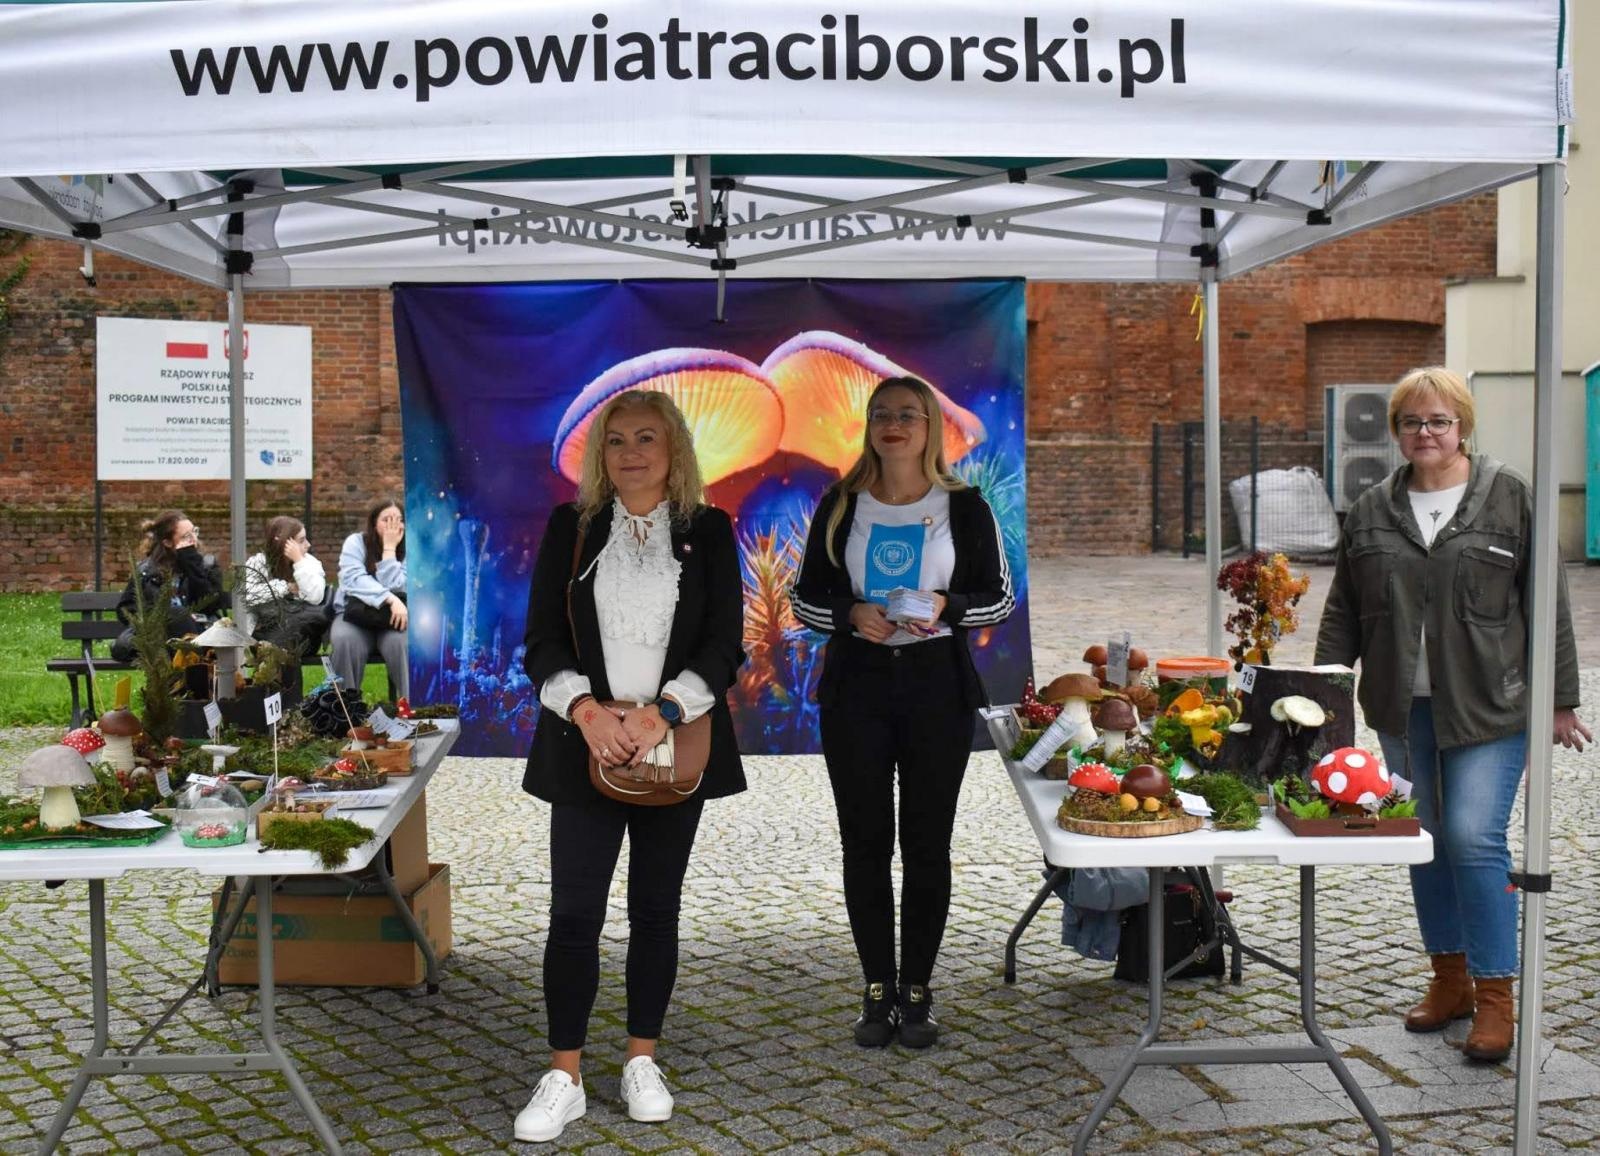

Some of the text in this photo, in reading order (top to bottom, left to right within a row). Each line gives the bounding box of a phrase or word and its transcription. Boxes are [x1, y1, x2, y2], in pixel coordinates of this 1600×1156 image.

[170, 13, 1186, 102] www.powiatraciborski.pl
[160, 369, 254, 380] RZĄDOWY FUNSZ
[181, 382, 214, 391] POLSKI
[109, 393, 302, 406] PROGRAM INWESTYCJI STTEGICZNYCH
[166, 417, 249, 426] POWIAT RACIBOI
[1243, 672, 1254, 686] 19
[268, 700, 280, 716] 10
